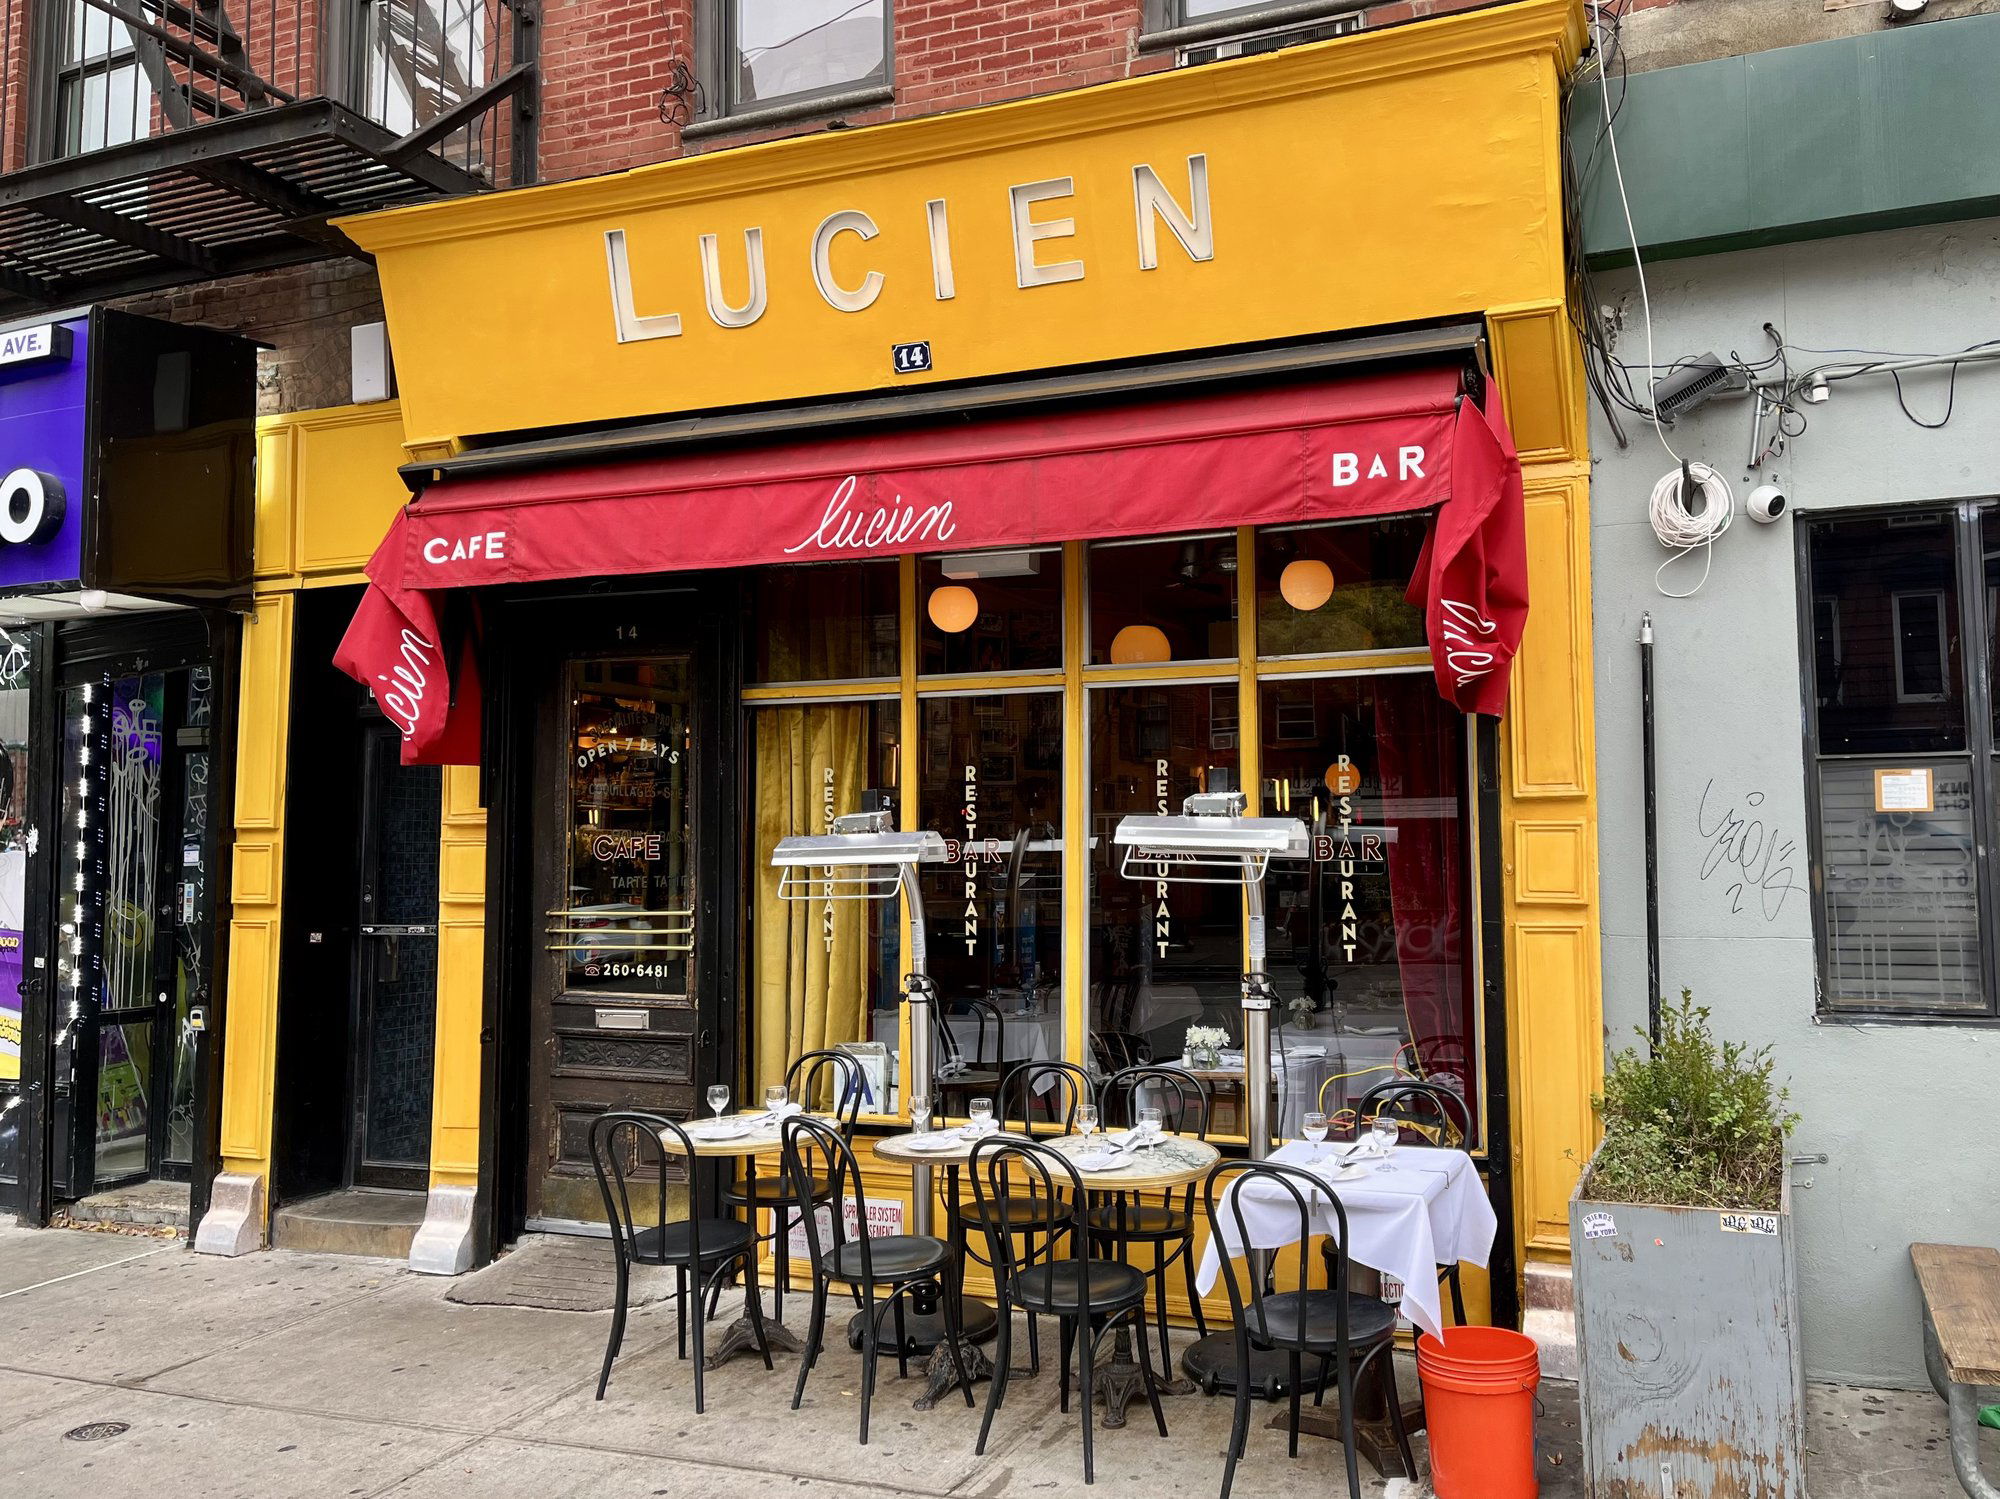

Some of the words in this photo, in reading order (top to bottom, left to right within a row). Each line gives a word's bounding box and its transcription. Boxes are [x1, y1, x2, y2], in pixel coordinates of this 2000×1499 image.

[604, 153, 1214, 344] LUCIEN
[2, 333, 42, 357] AVE.
[899, 347, 924, 368] 14
[1332, 445, 1426, 487] BAR
[784, 475, 956, 554] lucien
[423, 532, 506, 565] CAFE
[577, 739, 618, 768] OPEN
[625, 737, 634, 751] 7
[640, 738, 680, 764] DAYS
[593, 834, 661, 861] CAFE
[822, 767, 836, 953] RESTURANT
[943, 838, 1002, 863] BAR
[964, 765, 978, 956] RESTAURANT
[1156, 759, 1170, 959] RESURANT
[1313, 833, 1383, 862] BAR
[1337, 754, 1358, 962] RESTAURANT
[611, 876, 648, 889] TARTE
[845, 1064, 875, 1106] A
[877, 1207, 902, 1223] SYSTEM
[1583, 1213, 1612, 1225] FRIENDS
[1585, 1230, 1599, 1238] NEW
[1600, 1227, 1617, 1236] YORK
